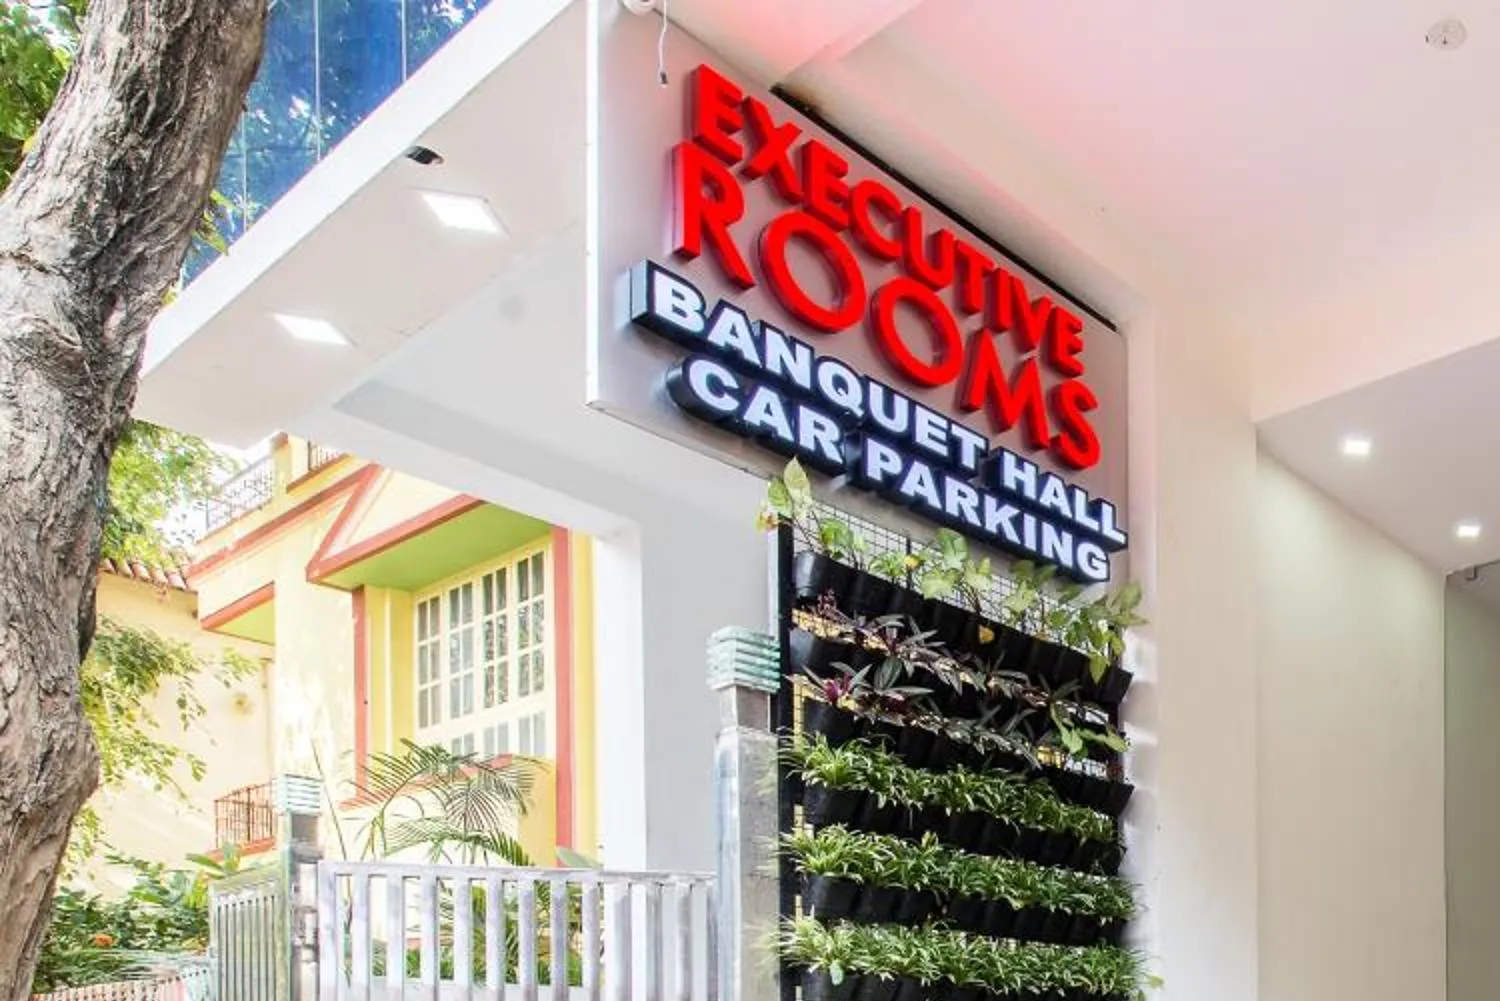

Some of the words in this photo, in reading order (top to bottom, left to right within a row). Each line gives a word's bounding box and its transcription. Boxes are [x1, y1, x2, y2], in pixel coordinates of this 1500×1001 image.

[672, 142, 1101, 470] ROOMS
[688, 63, 1085, 377] EXECUTIVE
[652, 269, 988, 470] BANQUET
[1002, 451, 1127, 546] HALL
[688, 359, 844, 464] CAR
[865, 439, 1110, 581] PARKING
